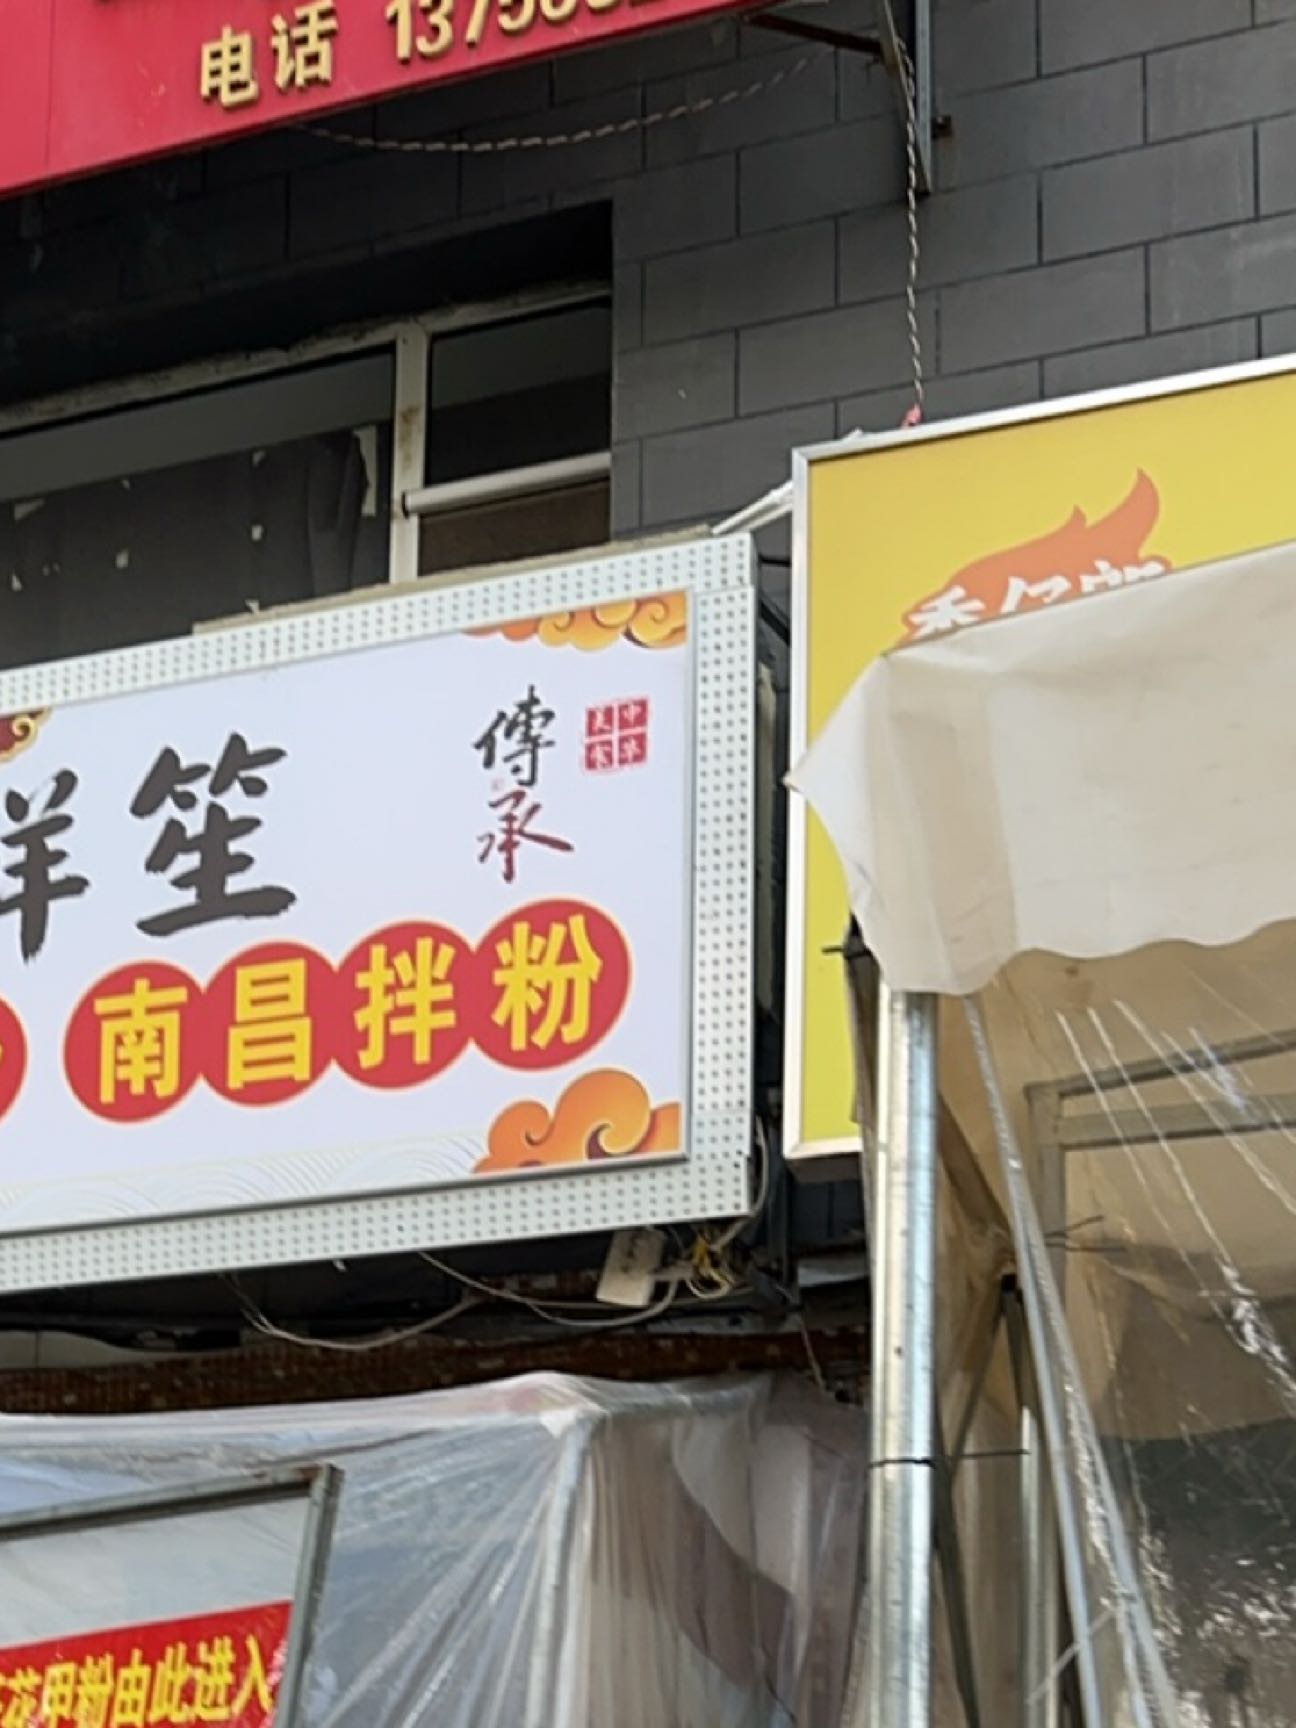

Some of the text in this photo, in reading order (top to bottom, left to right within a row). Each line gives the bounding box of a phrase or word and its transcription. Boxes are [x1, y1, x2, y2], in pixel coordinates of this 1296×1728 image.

[200, 0, 339, 105] 电话
[92, 914, 603, 1105] 南昌拌粉
